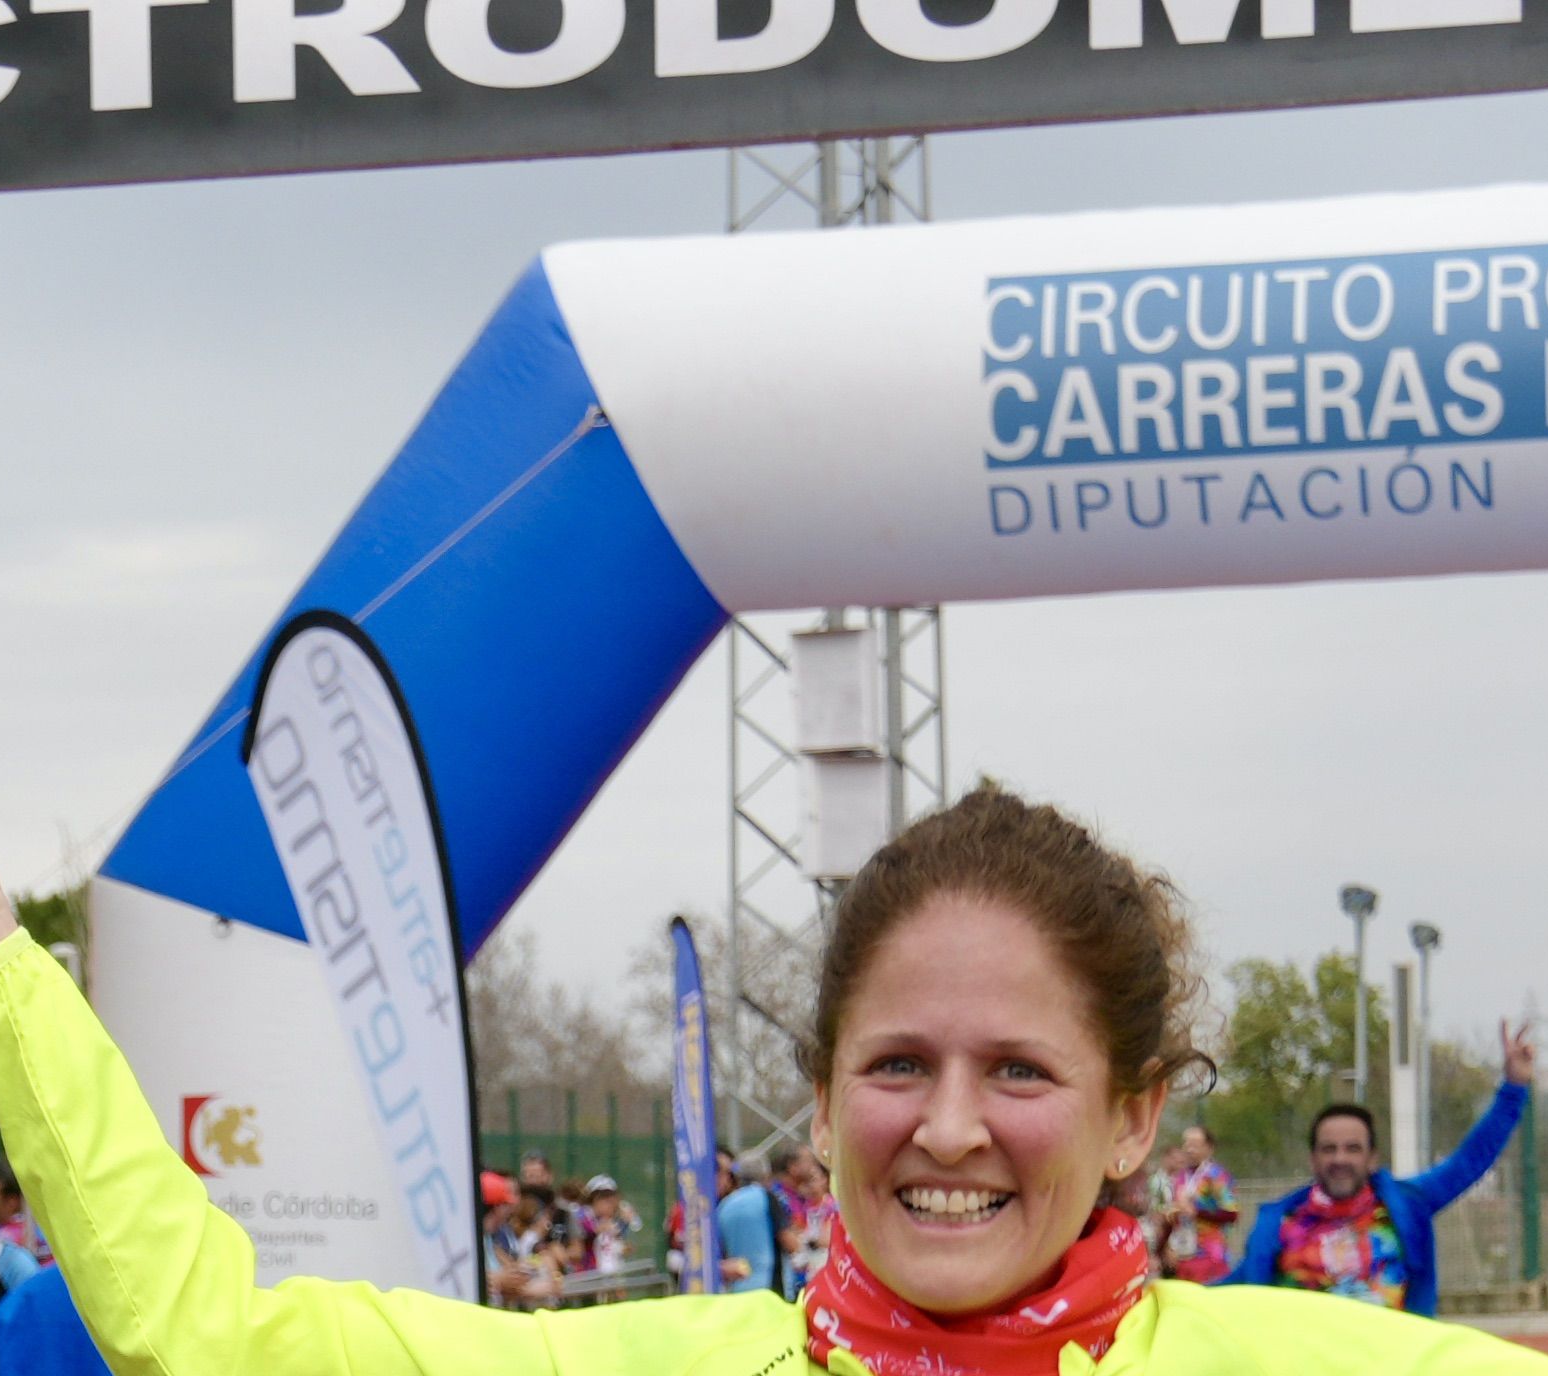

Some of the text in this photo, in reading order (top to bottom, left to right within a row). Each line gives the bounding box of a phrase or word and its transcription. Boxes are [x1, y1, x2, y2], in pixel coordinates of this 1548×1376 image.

[982, 262, 1395, 363] CIRCUITO
[983, 342, 1504, 463] CARRERAS
[988, 446, 1495, 537] DIPUTACIÓN
[262, 1190, 380, 1220] Córdoba
